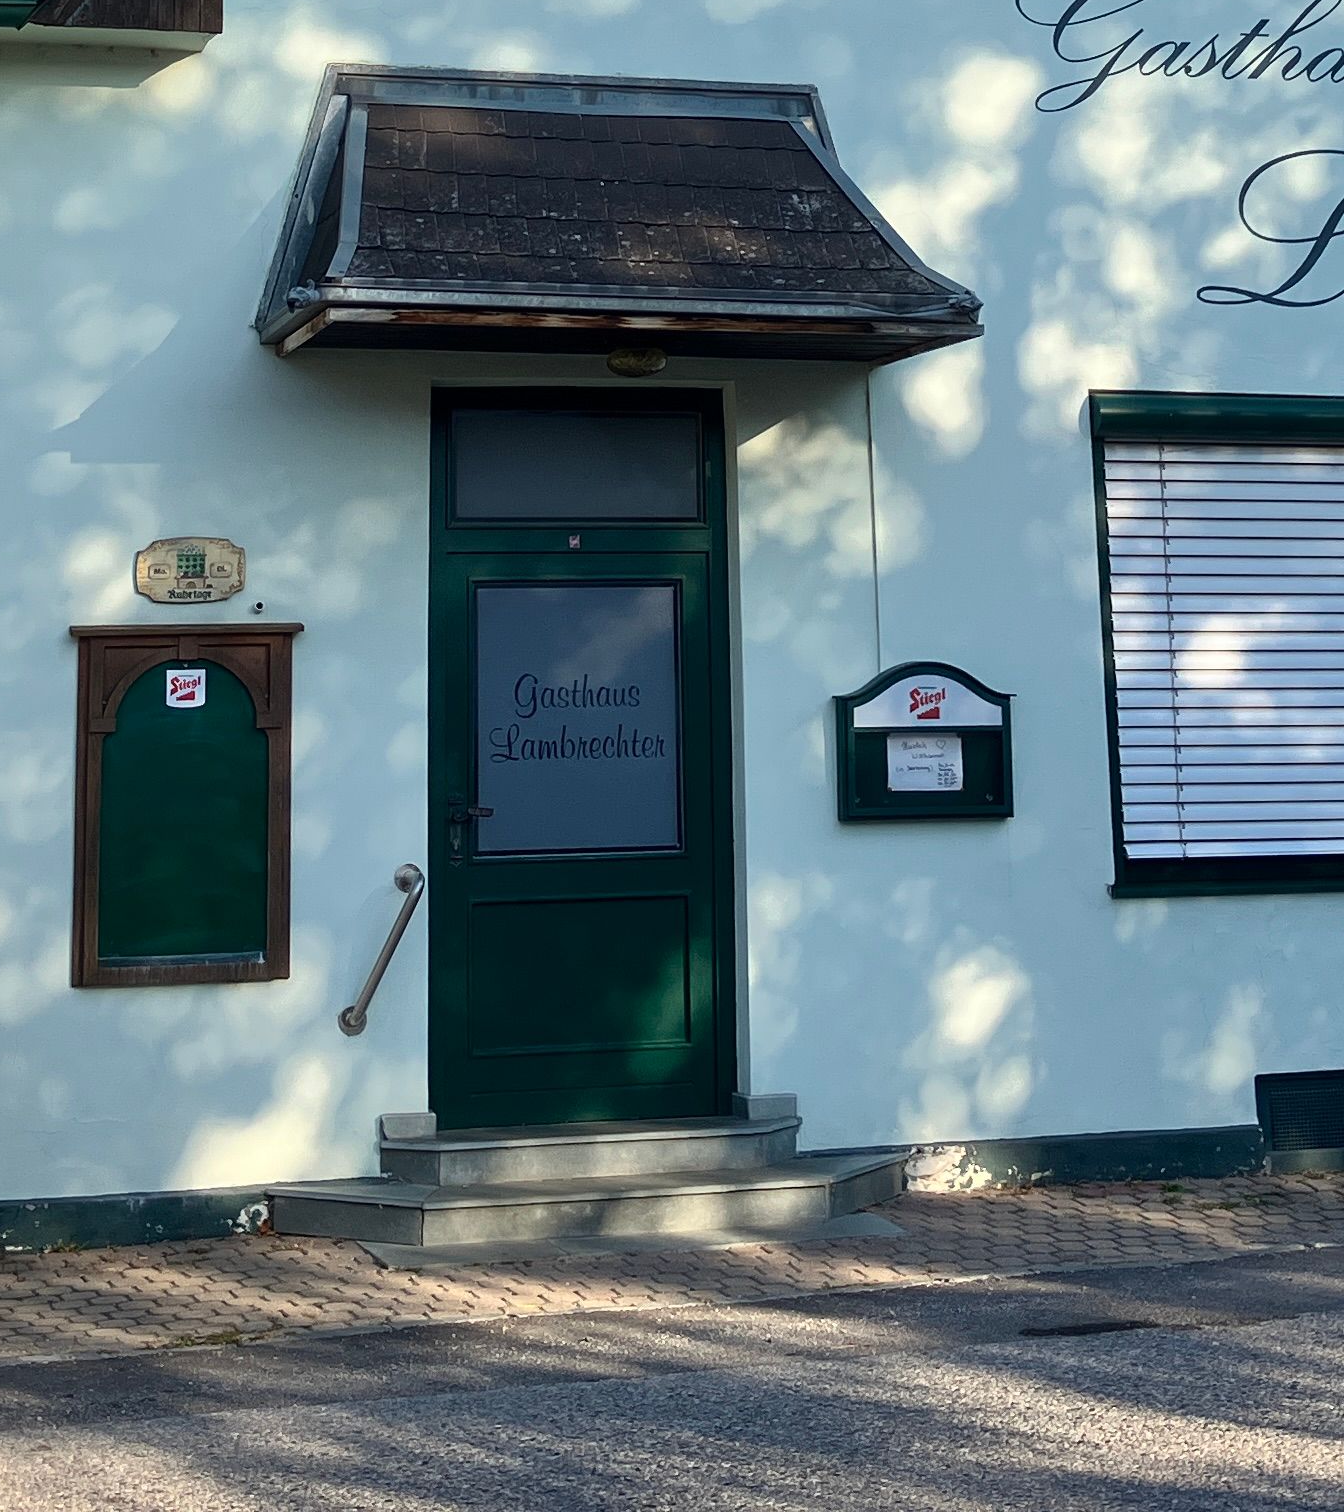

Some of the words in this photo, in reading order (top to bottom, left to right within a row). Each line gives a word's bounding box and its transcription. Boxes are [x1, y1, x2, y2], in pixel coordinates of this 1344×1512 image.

[170, 675, 202, 696] Stiegl
[514, 673, 640, 719] Gasthaus
[909, 687, 946, 713] Stiegl
[488, 723, 666, 764] Lambrechter
